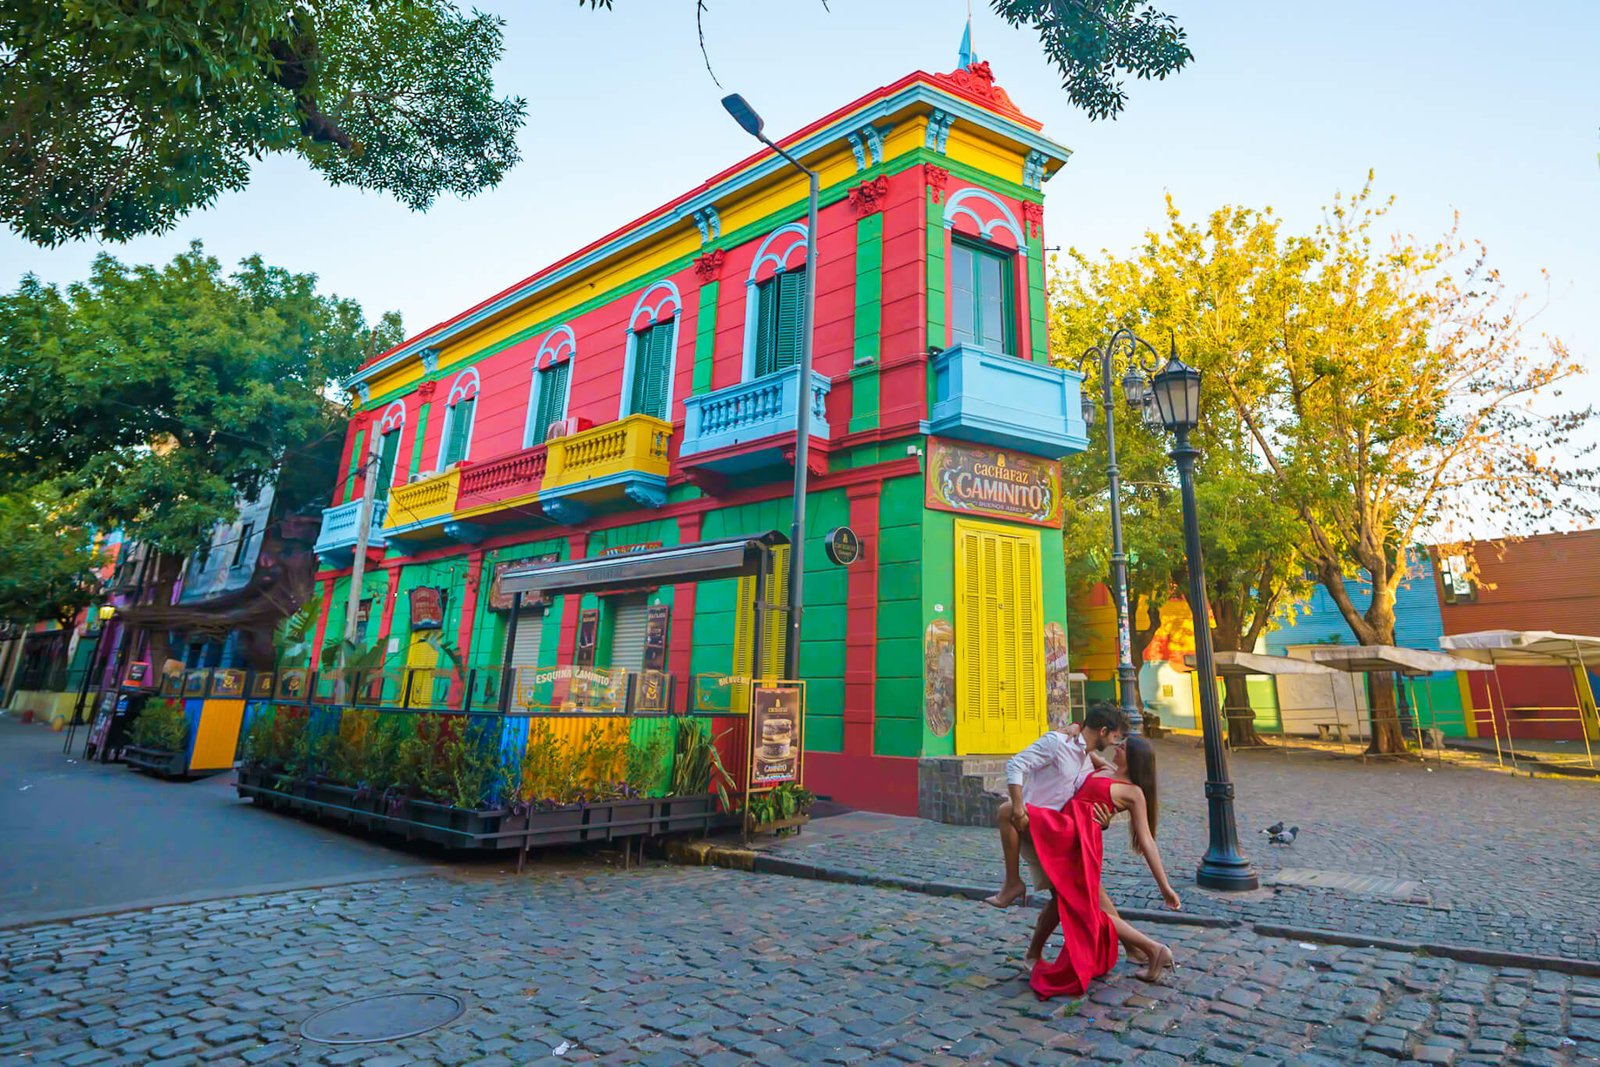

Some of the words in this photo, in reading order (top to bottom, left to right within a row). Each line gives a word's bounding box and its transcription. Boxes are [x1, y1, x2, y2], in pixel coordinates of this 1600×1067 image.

[957, 472, 1042, 510] CAMINITO
[536, 669, 572, 684] ESQUINA
[574, 669, 609, 686] CAMINITO
